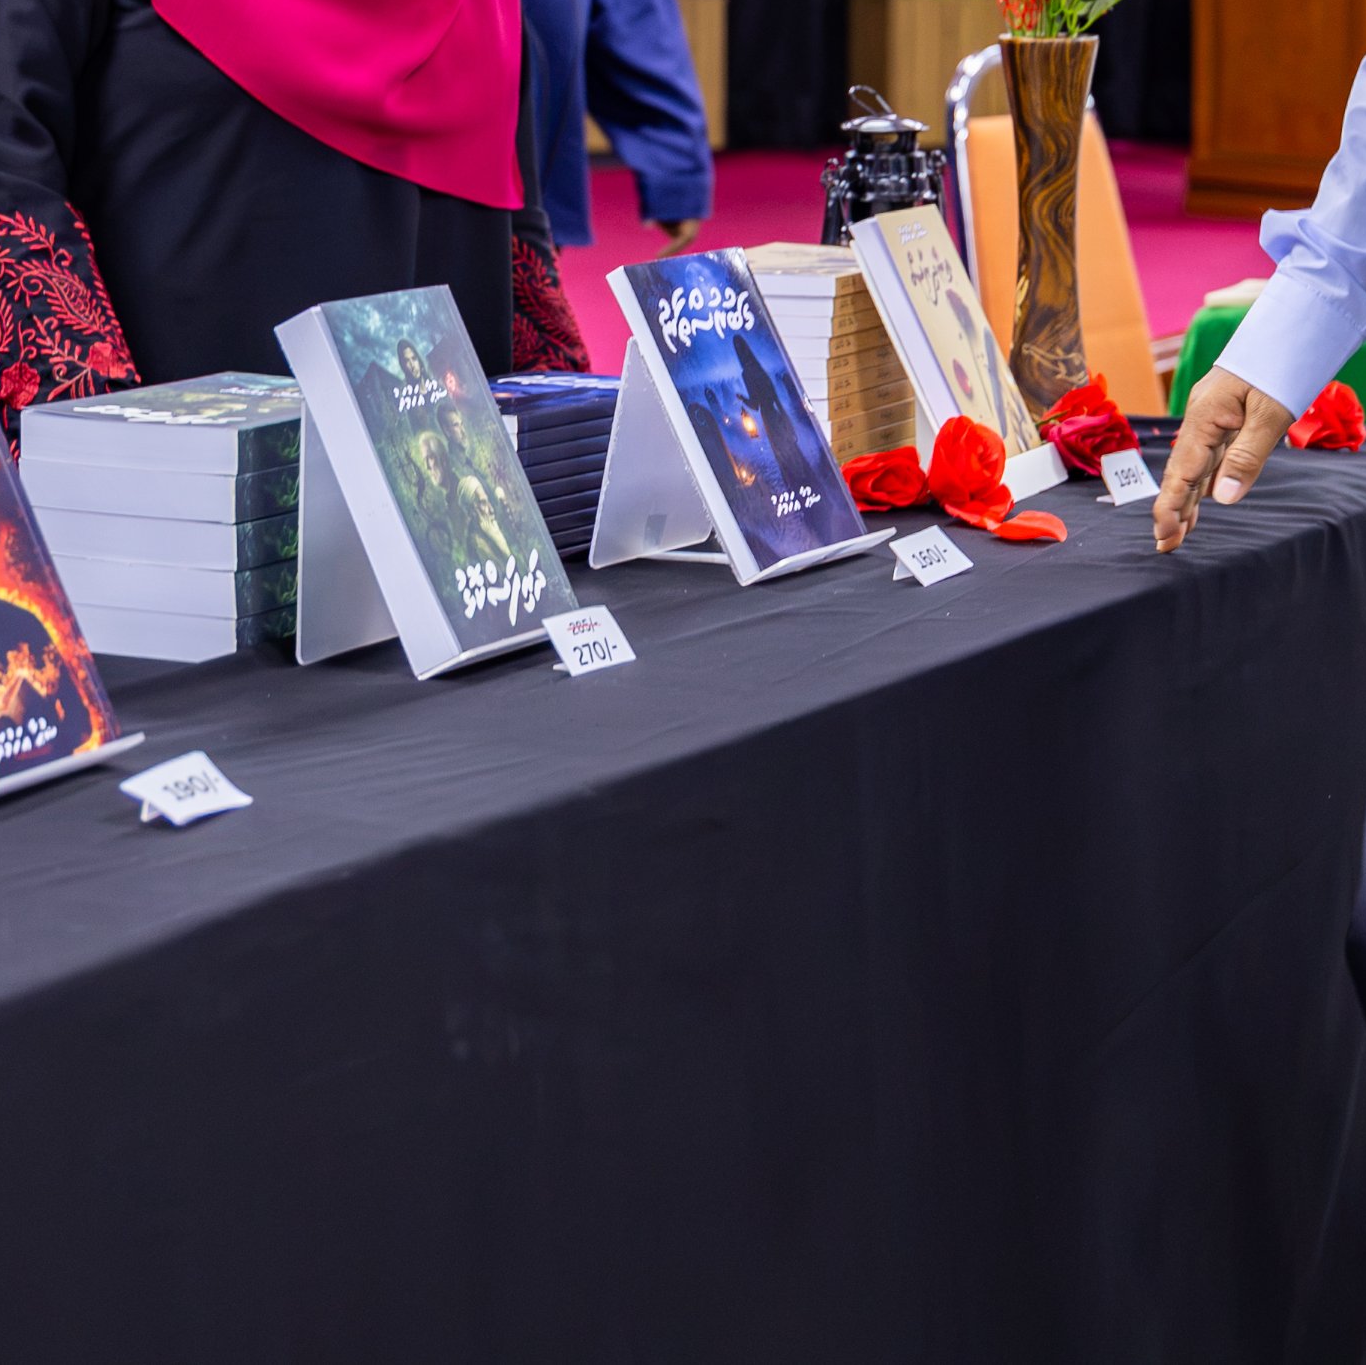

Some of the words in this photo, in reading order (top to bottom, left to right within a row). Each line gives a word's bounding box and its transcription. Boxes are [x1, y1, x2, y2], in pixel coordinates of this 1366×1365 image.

[1114, 465, 1144, 488] 199/-
[911, 544, 948, 569] 160/-
[572, 637, 618, 667] 270/-
[162, 770, 220, 801] 190/-
